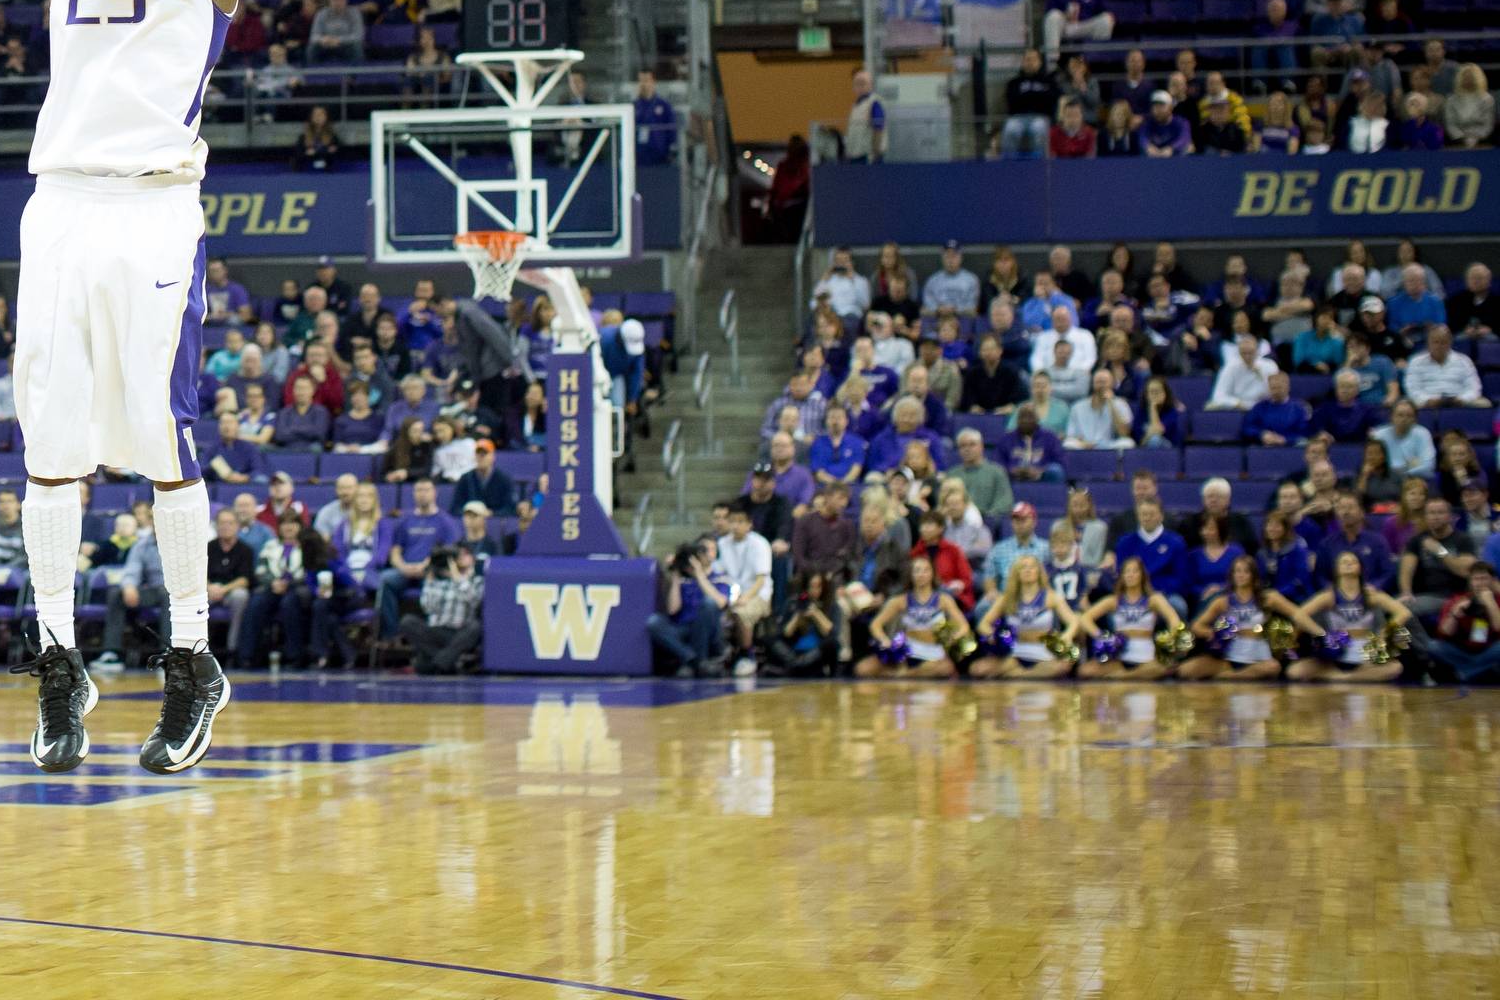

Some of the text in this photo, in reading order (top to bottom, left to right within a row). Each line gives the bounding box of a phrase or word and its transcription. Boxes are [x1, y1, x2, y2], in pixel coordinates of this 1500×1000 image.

[1235, 167, 1482, 217] BE GOLD
[559, 369, 580, 540] HUSKIES
[516, 583, 621, 661] W
